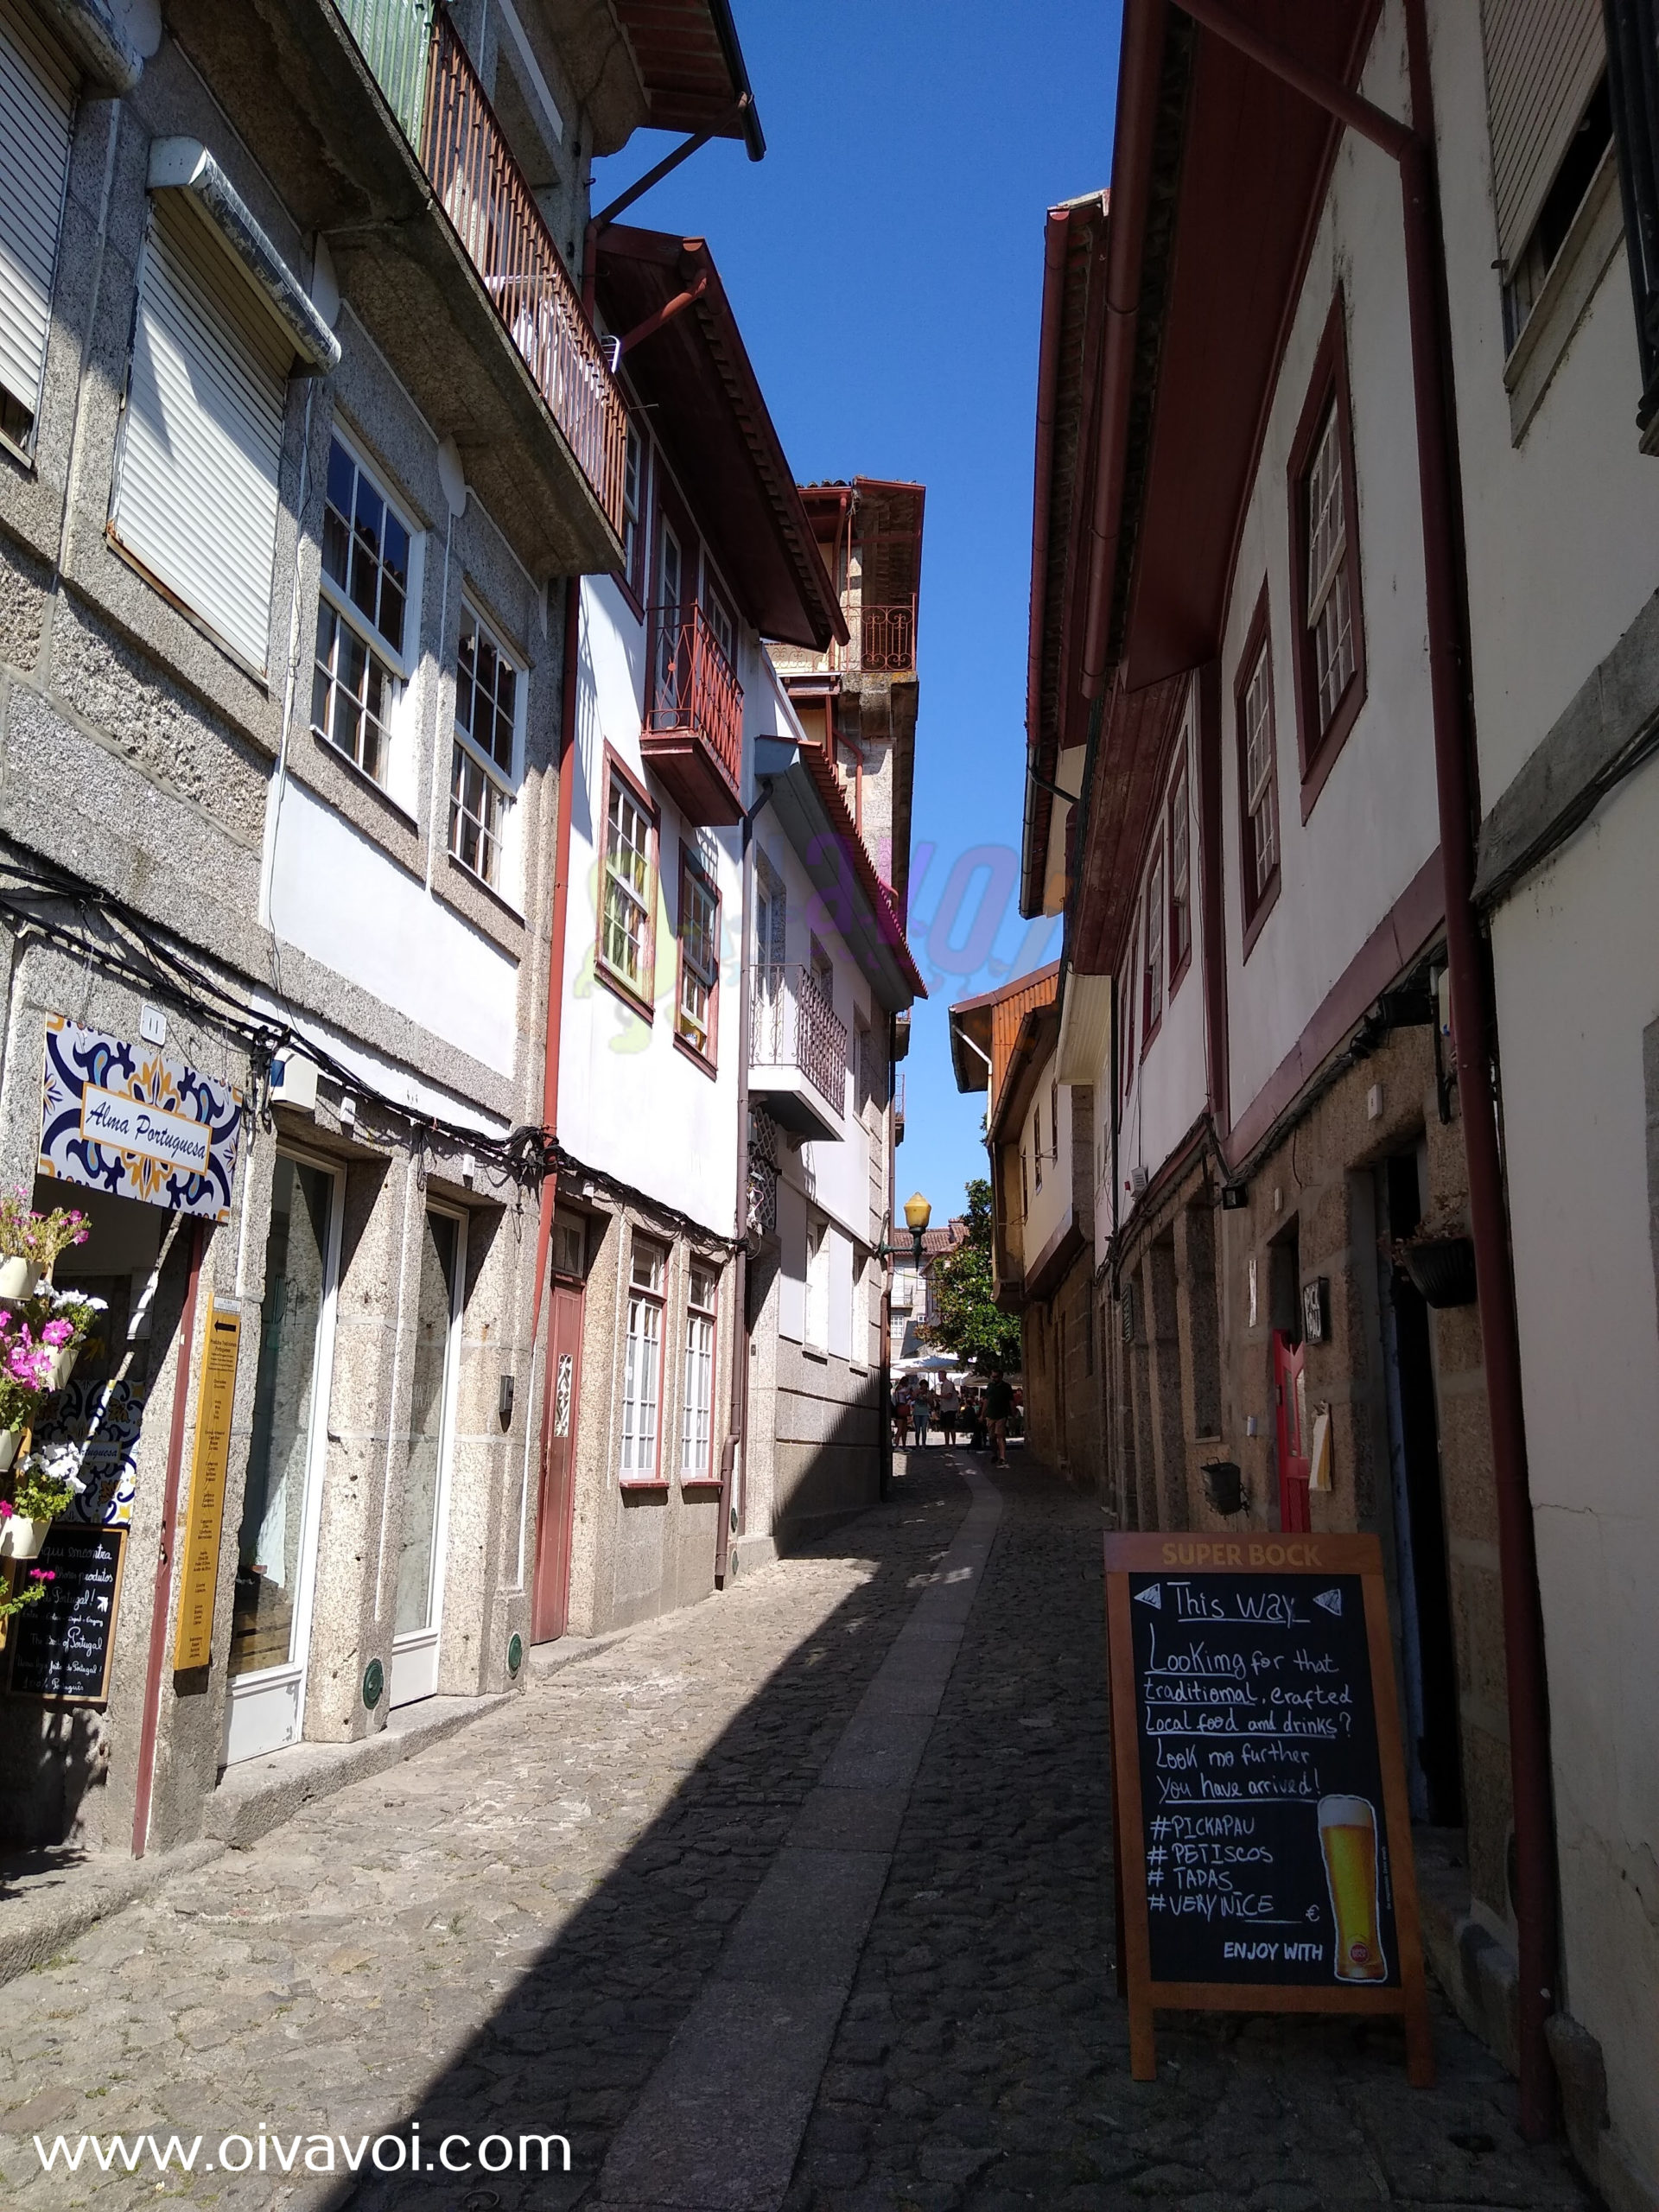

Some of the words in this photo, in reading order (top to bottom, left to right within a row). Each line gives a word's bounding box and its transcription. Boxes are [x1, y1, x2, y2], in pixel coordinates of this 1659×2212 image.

[86, 1100, 130, 1133] Alma
[135, 1114, 207, 1160] Portuguesa
[1161, 1542, 1243, 1567] SUPER
[1249, 1543, 1322, 1567] BOCK
[1166, 1581, 1224, 1618] This
[67, 1625, 103, 1657] Portugal
[1250, 1650, 1286, 1676] for
[1293, 1649, 1339, 1674] that
[1146, 1706, 1192, 1732] Local
[1196, 1707, 1236, 1733] food
[1248, 1712, 1275, 1732] and
[1209, 1751, 1234, 1767] no
[1241, 1740, 1310, 1764] further
[1200, 1772, 1243, 1797] have
[1248, 1768, 1321, 1796] arrived!
[1149, 1815, 1255, 1840] #PICKAPAU
[1305, 1904, 1320, 1923] €
[1223, 1941, 1279, 1961] ENJOY
[1283, 1942, 1323, 1961] WITH
